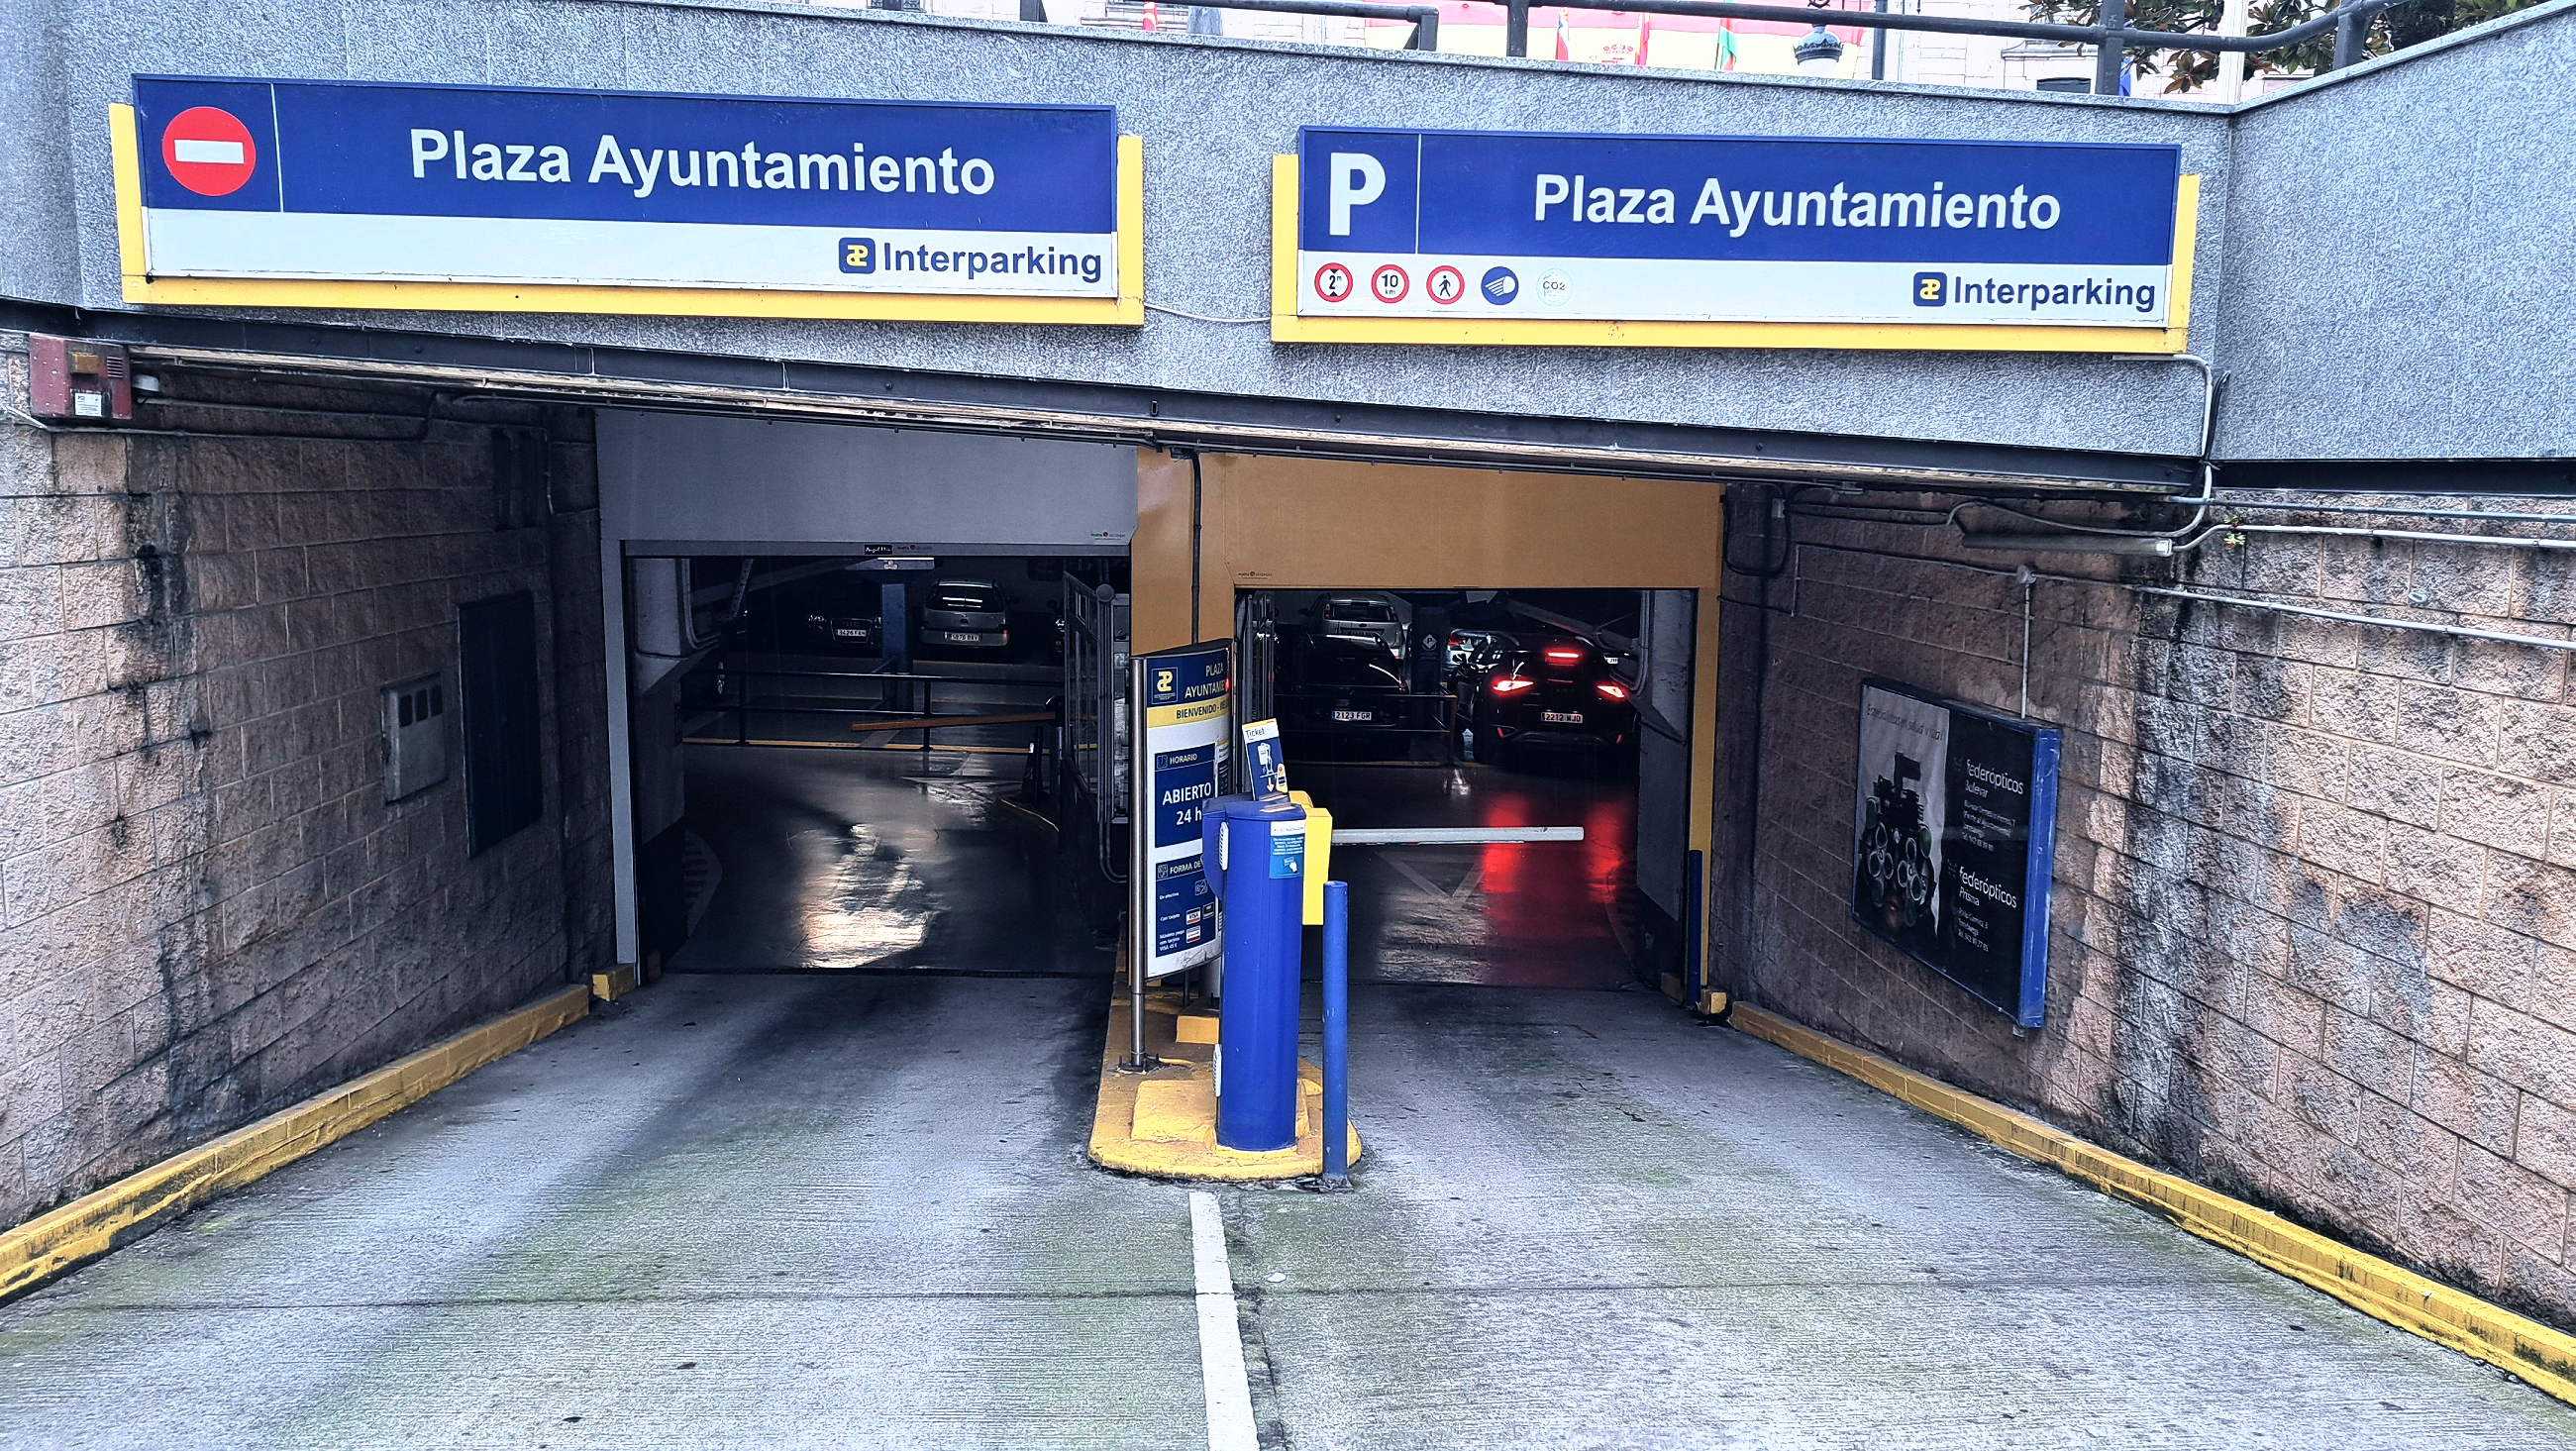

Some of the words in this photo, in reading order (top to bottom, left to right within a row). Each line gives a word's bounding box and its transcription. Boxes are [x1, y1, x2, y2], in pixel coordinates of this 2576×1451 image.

[411, 129, 570, 183] Plaza
[587, 135, 995, 199] Ayuntamiento
[1329, 153, 1387, 237] P
[1535, 174, 1675, 226] Plaza
[1689, 178, 2061, 239] Ayuntamiento
[884, 242, 1101, 284] Interparking
[1382, 273, 1398, 287] 10
[1955, 276, 2156, 313] Interparking
[1205, 663, 1223, 676] PLAZA
[1176, 704, 1216, 719] BIENVENIDO
[1546, 713, 1564, 722] 2212
[1245, 727, 1265, 738] Ticket
[1170, 753, 1197, 765] HORARIO
[1966, 759, 2024, 795] federópticos
[1162, 781, 1211, 806] ABIERTO
[1176, 808, 1191, 825] 24
[1194, 805, 1202, 821] h
[1170, 862, 1193, 875] FORMA
[1193, 860, 1201, 870] DE
[1959, 866, 2017, 908] federópticos
